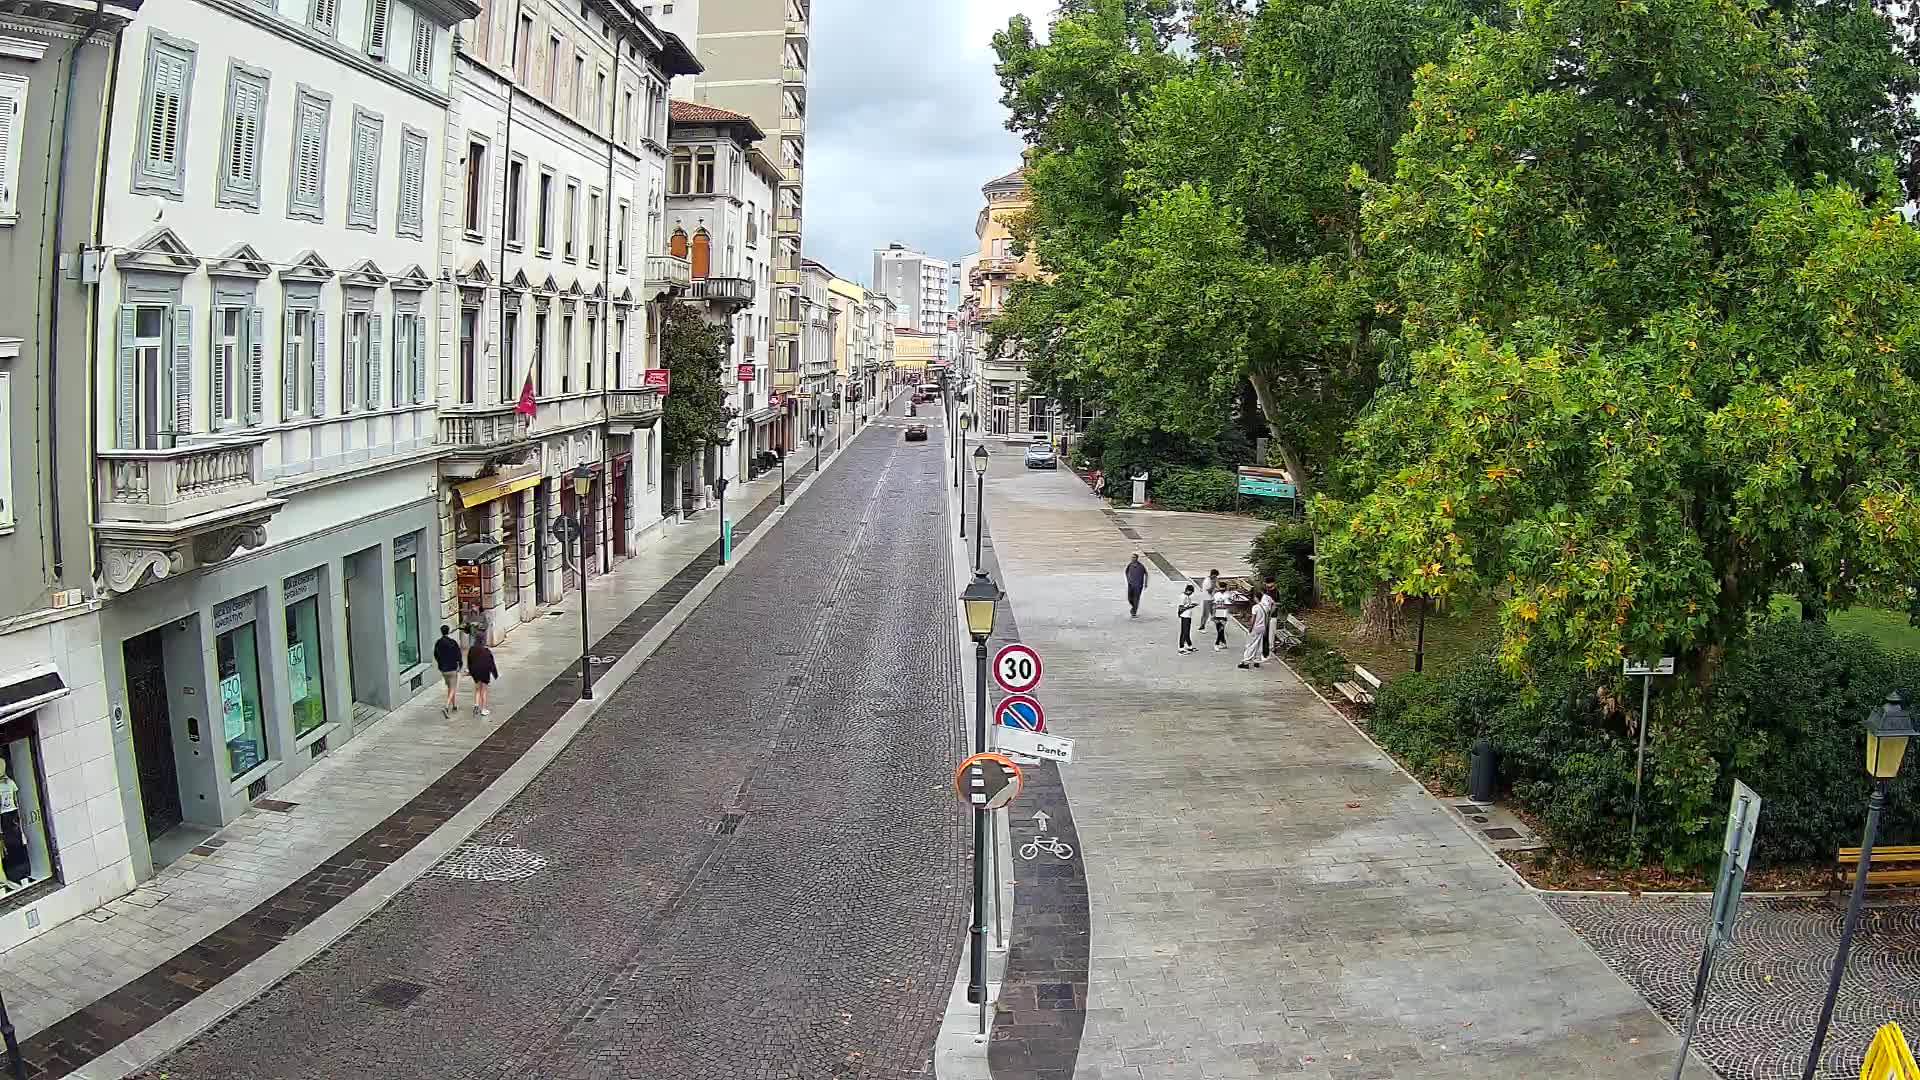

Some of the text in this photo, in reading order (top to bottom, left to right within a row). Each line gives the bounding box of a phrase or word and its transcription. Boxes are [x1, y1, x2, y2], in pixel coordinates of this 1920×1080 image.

[1005, 657, 1031, 680] 30
[221, 678, 240, 699] 130
[1037, 743, 1067, 757] Dante
